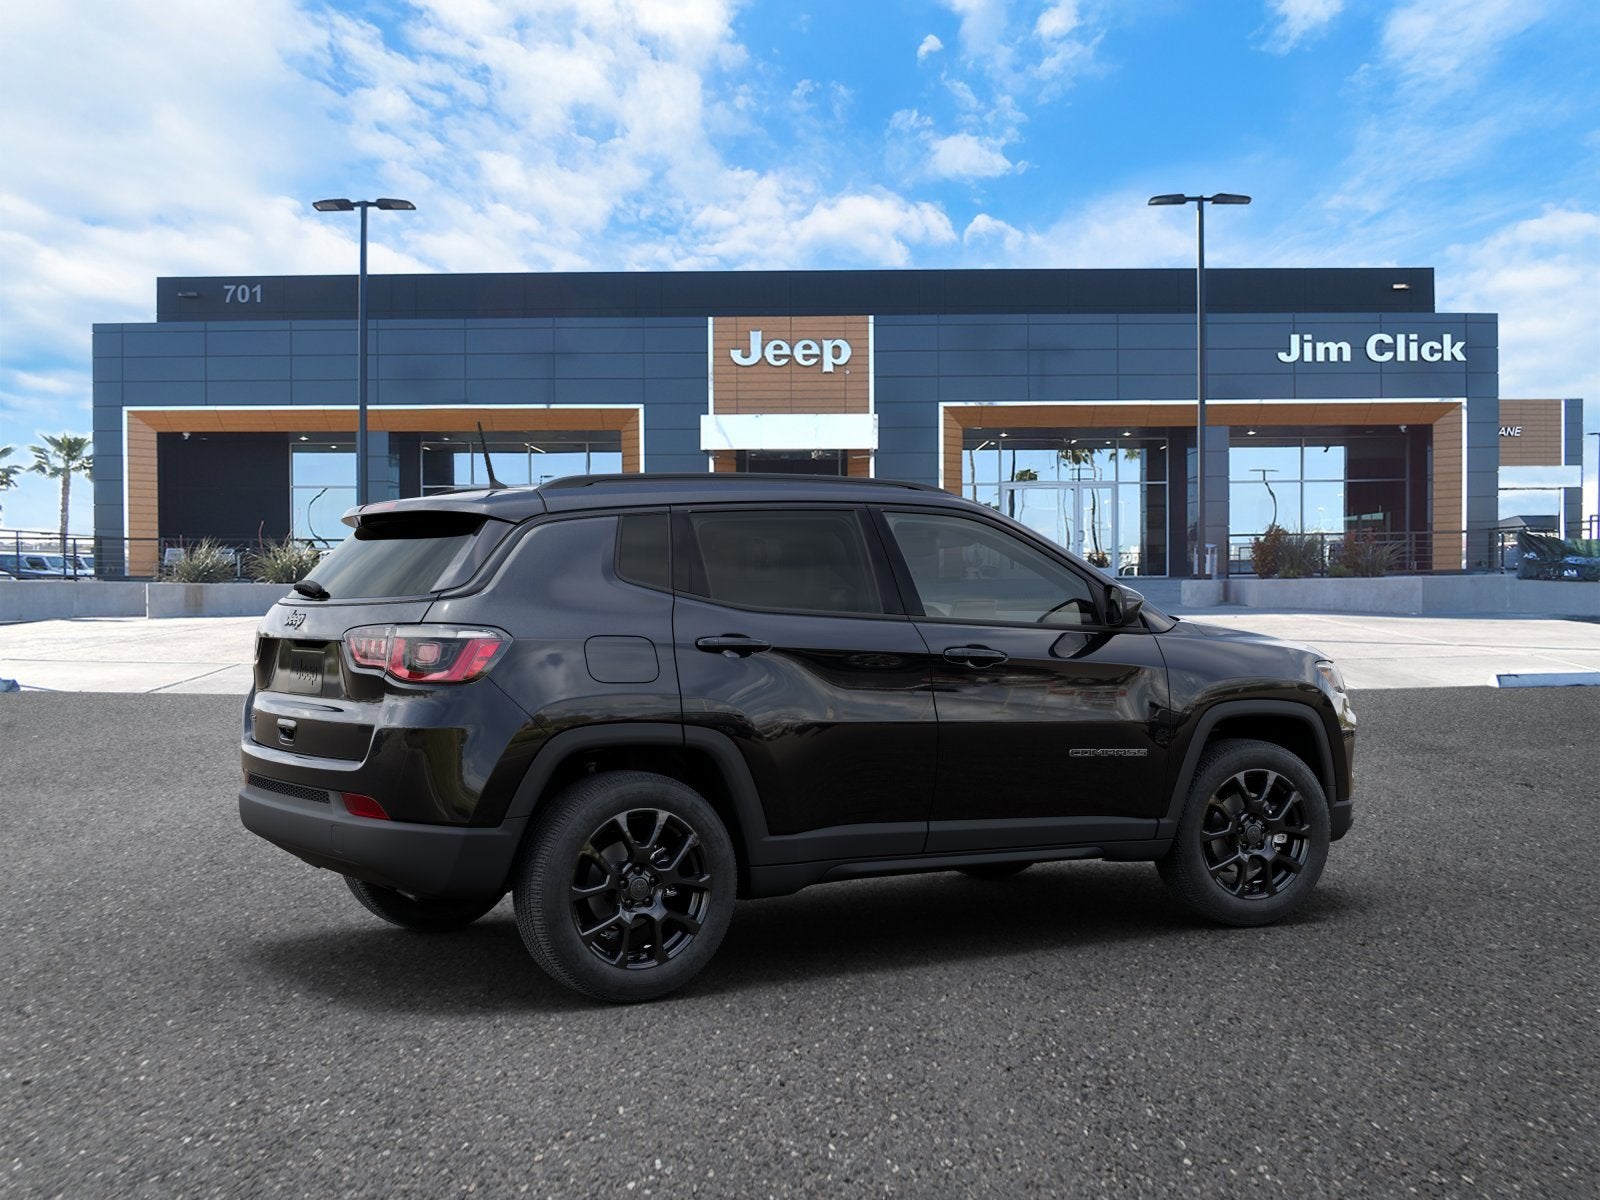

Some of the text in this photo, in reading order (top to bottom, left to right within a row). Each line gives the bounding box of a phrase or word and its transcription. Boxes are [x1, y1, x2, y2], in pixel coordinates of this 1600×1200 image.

[223, 284, 262, 303] 701
[729, 330, 852, 373] Jeep
[1277, 333, 1467, 363] Jim Click
[1069, 748, 1148, 757] COMPASS
